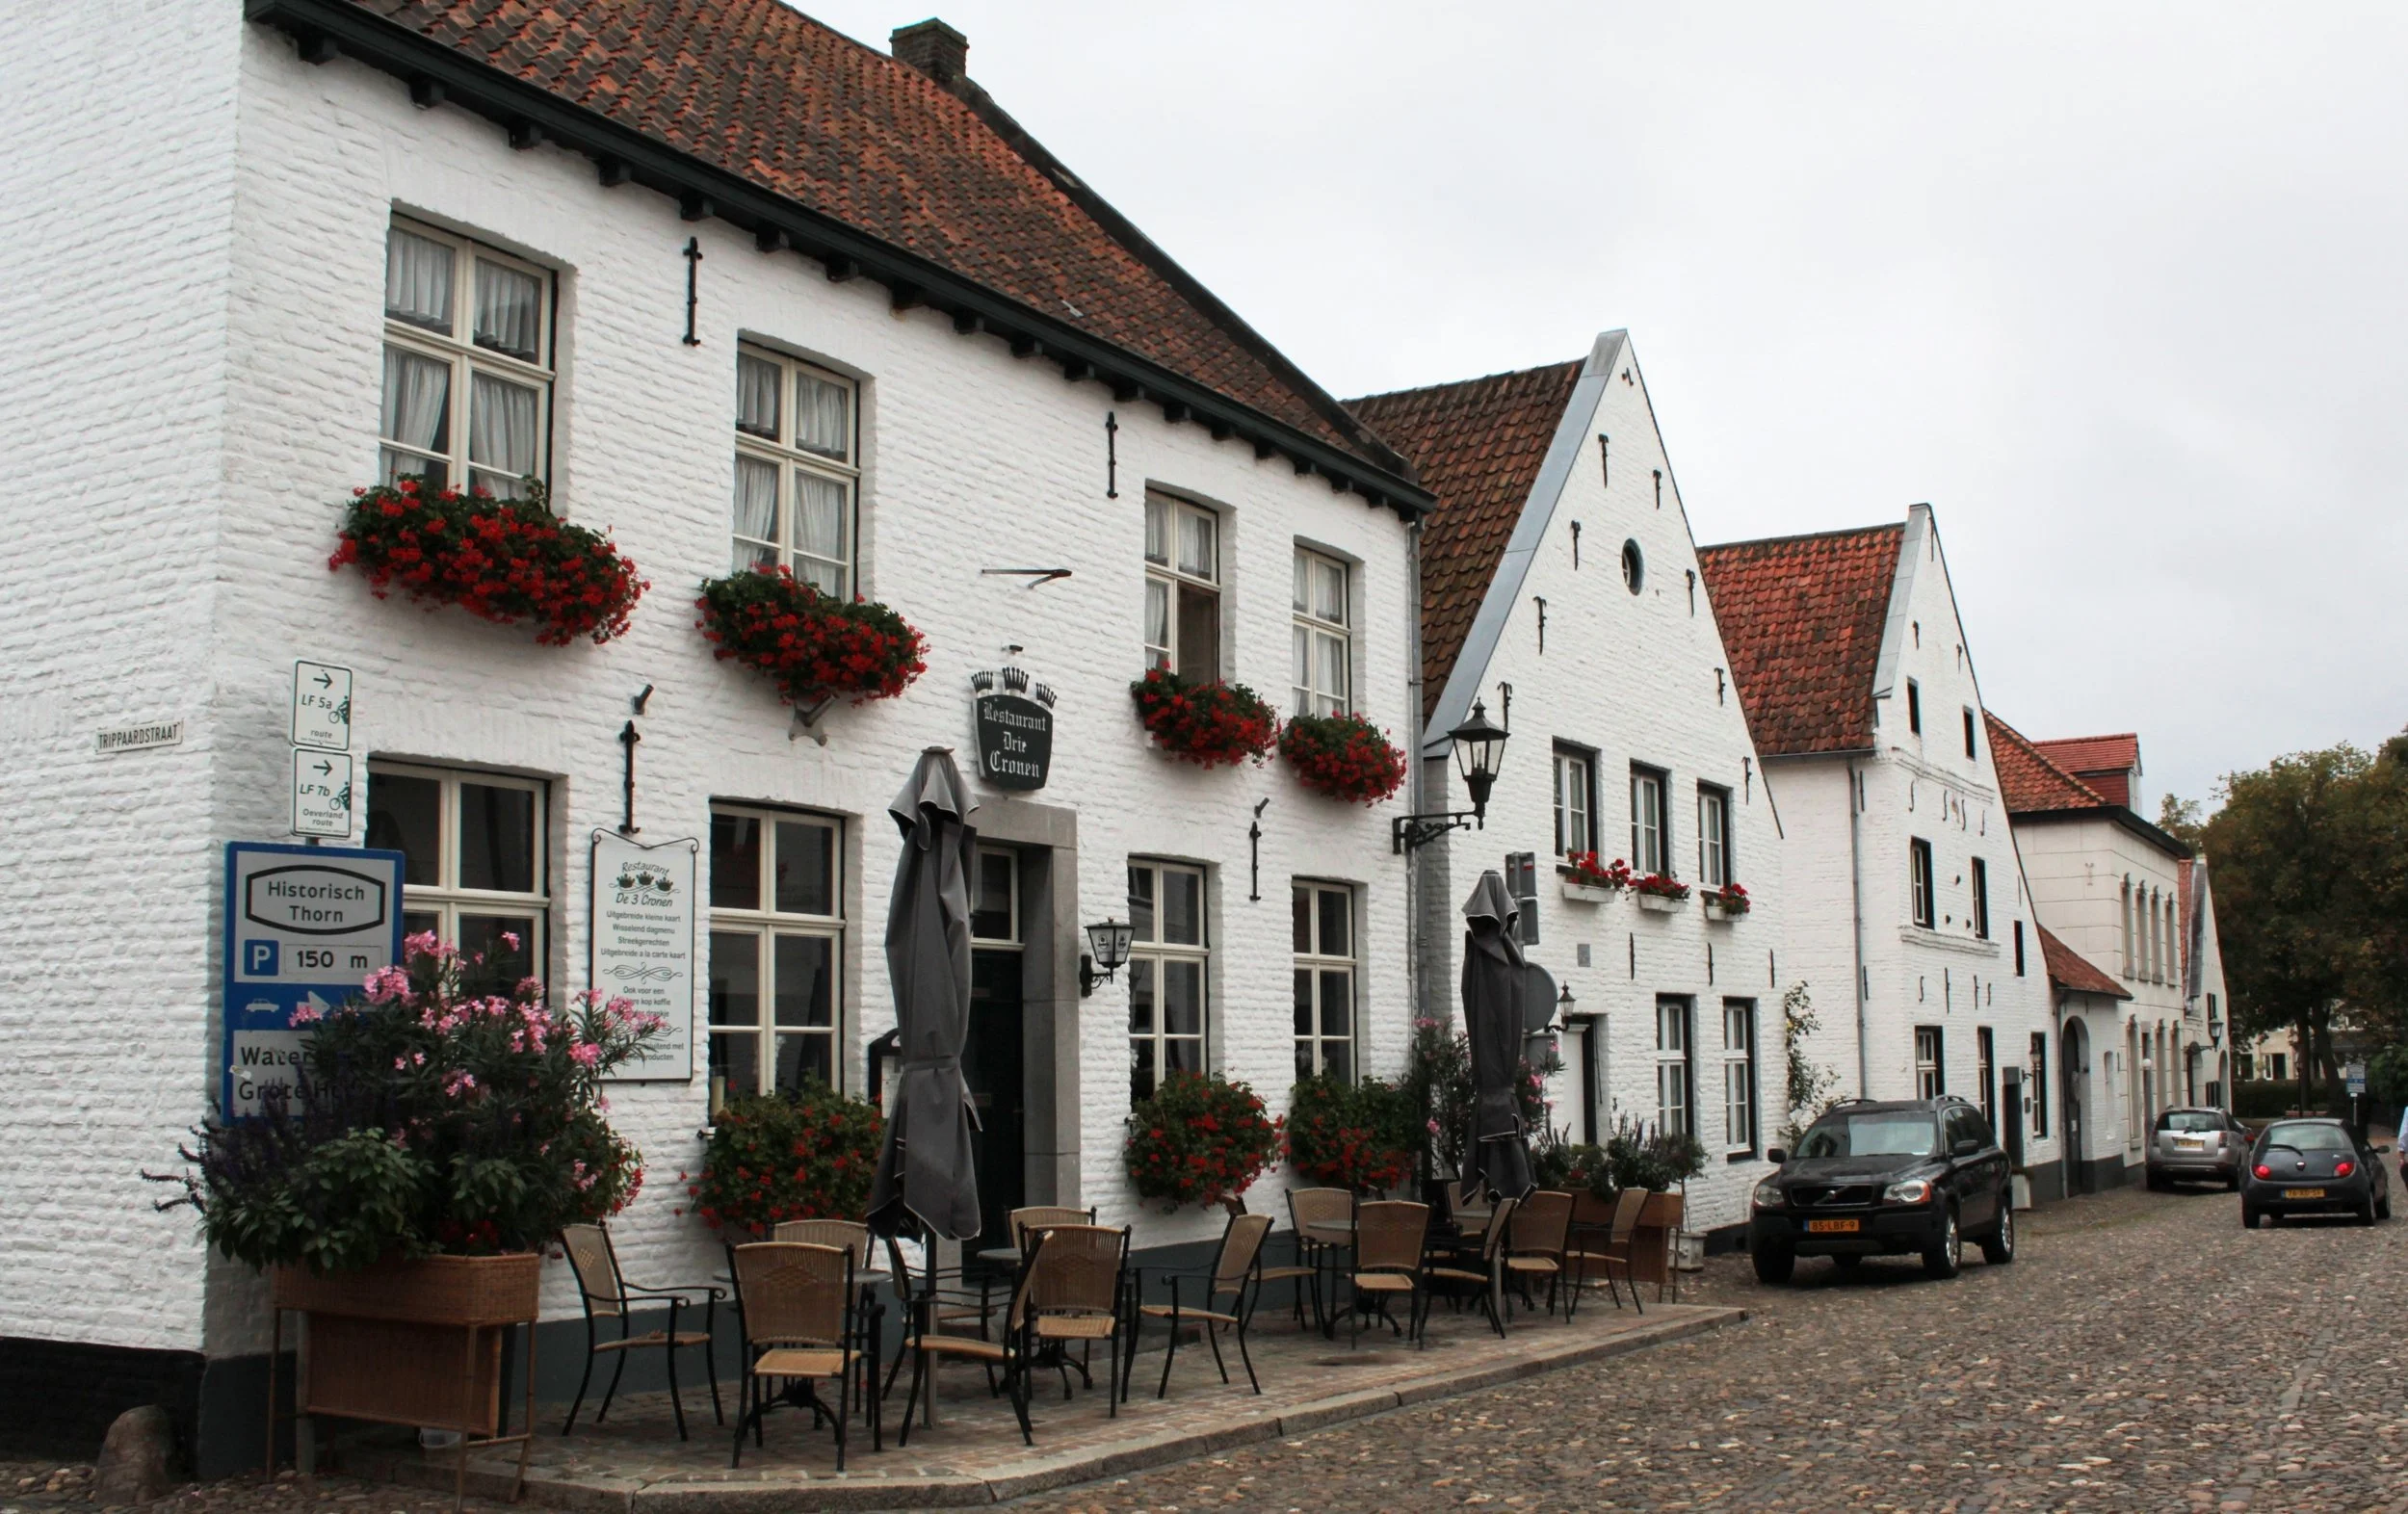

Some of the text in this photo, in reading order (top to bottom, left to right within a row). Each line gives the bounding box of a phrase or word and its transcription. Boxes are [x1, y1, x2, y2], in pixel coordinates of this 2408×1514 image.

[301, 693, 332, 710] LF 5a
[983, 702, 1046, 732] Restaurant
[98, 724, 178, 749] TRIPPAARDSTRAAT
[310, 729, 333, 740] route
[1003, 731, 1027, 752] Drie
[989, 750, 1039, 778] Cronen
[300, 783, 330, 797] LF 7b
[302, 808, 344, 820] Oeverland
[312, 819, 333, 827] route
[621, 861, 670, 876] Restaurant
[268, 881, 365, 901] Historisch
[615, 892, 673, 907] De 3 Cronen
[289, 905, 344, 923] Thorn
[606, 910, 643, 921] Uitgebreide
[613, 924, 675, 935] Wisselend dagmenu
[617, 936, 670, 947] Streekgerechten
[253, 945, 368, 971] P 150 m
[600, 948, 639, 958] Uitgebreide
[623, 985, 636, 994] Ook
